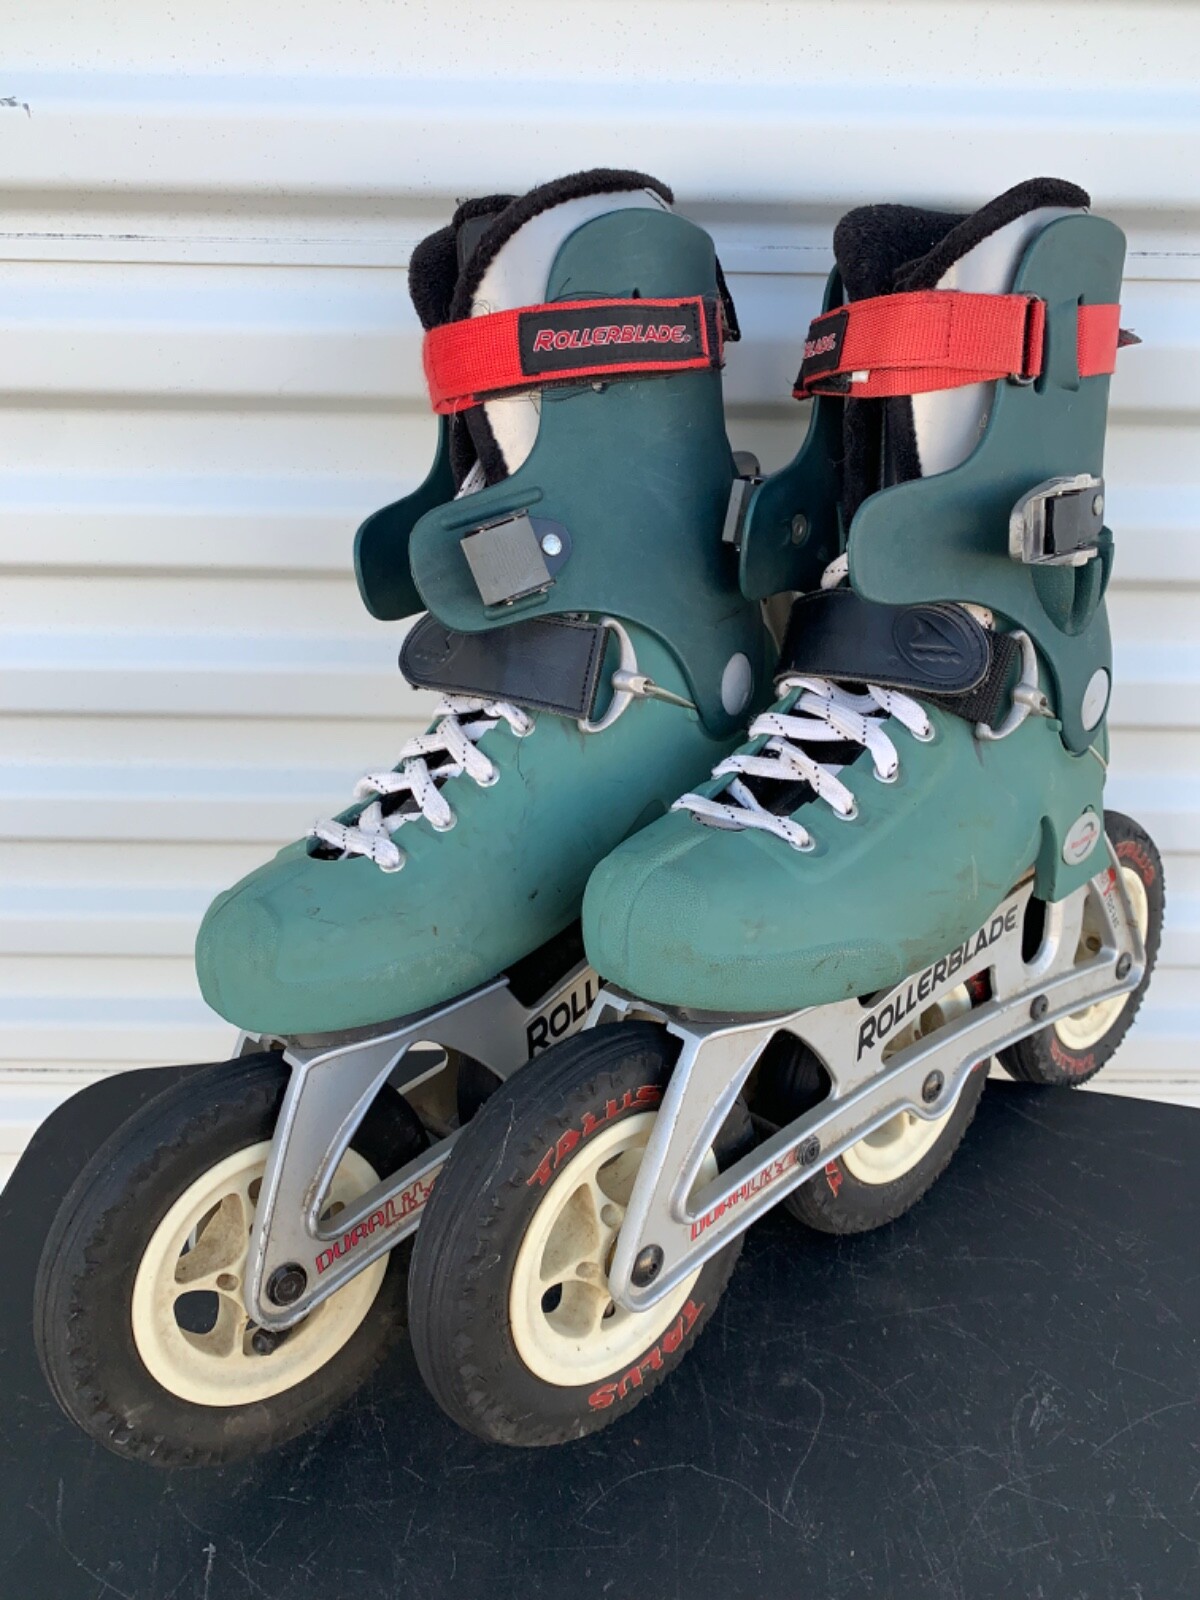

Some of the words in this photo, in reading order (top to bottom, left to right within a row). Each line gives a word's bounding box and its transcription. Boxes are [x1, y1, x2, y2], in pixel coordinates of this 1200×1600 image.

[856, 904, 1019, 1062] ROLLERBLADE
[526, 1084, 663, 1188] TALUS
[587, 1299, 706, 1413] TALUS
